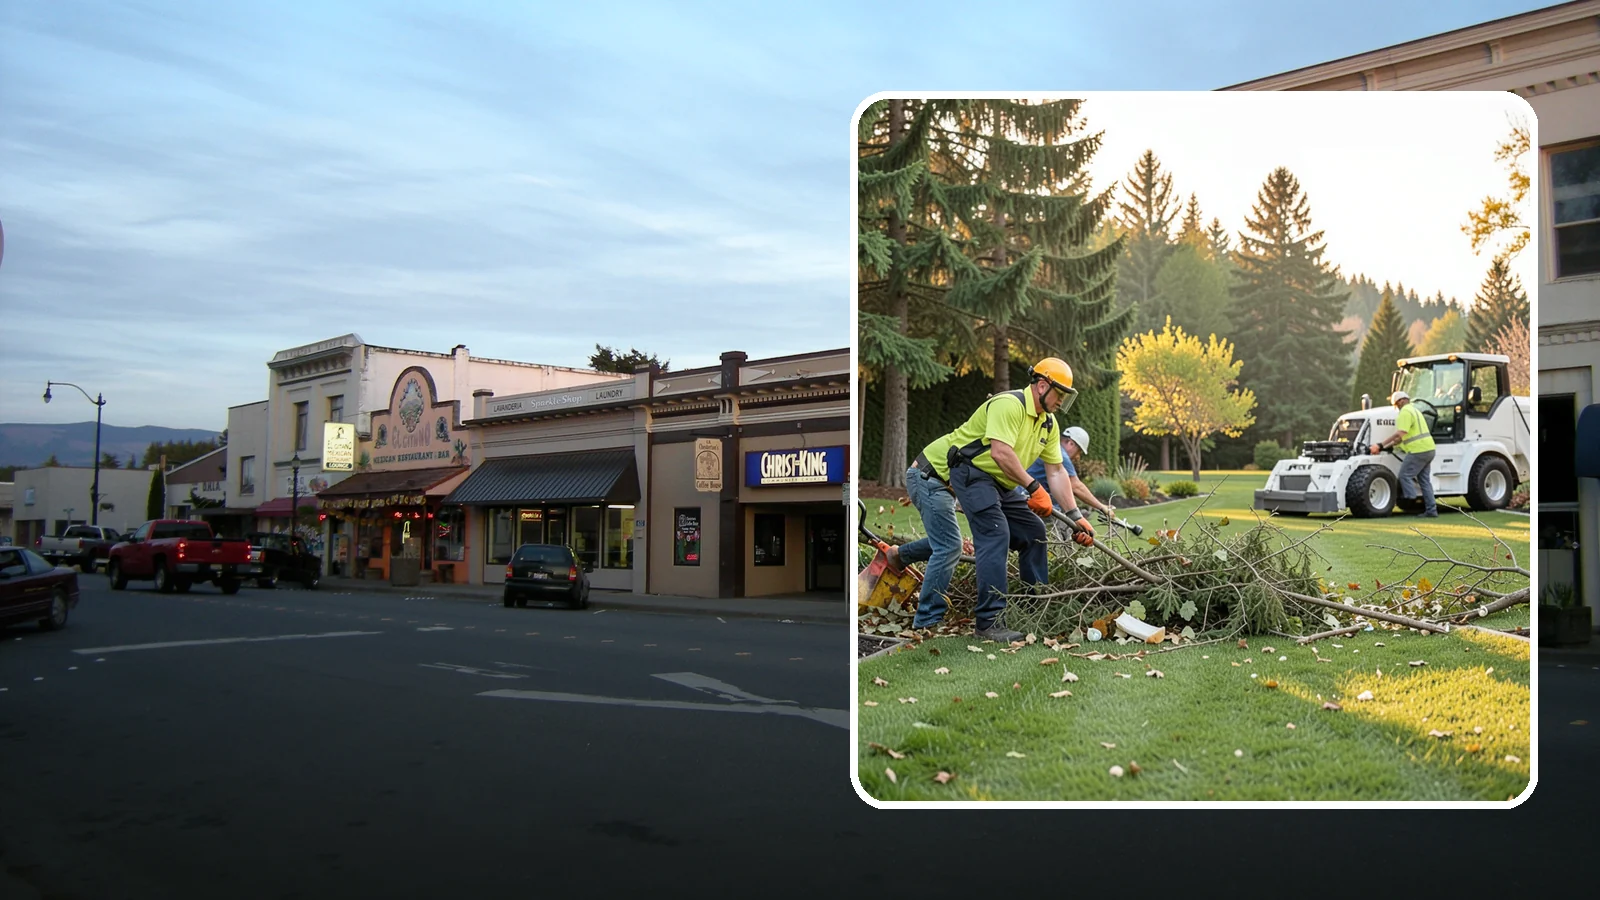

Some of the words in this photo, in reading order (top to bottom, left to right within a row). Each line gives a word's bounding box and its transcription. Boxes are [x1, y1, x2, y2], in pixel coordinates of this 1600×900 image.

[595, 388, 623, 400] LAUNDRY
[493, 402, 522, 413] LAVANDERIA
[531, 396, 561, 408] Sparkle
[561, 394, 582, 405] Shop
[374, 455, 396, 464] MEXICAN
[397, 451, 434, 462] RESTAURANT
[437, 450, 450, 459] BAR
[761, 452, 797, 478] CHRIST
[799, 450, 827, 476] KING
[696, 481, 709, 489] Coffee
[710, 481, 722, 489] House
